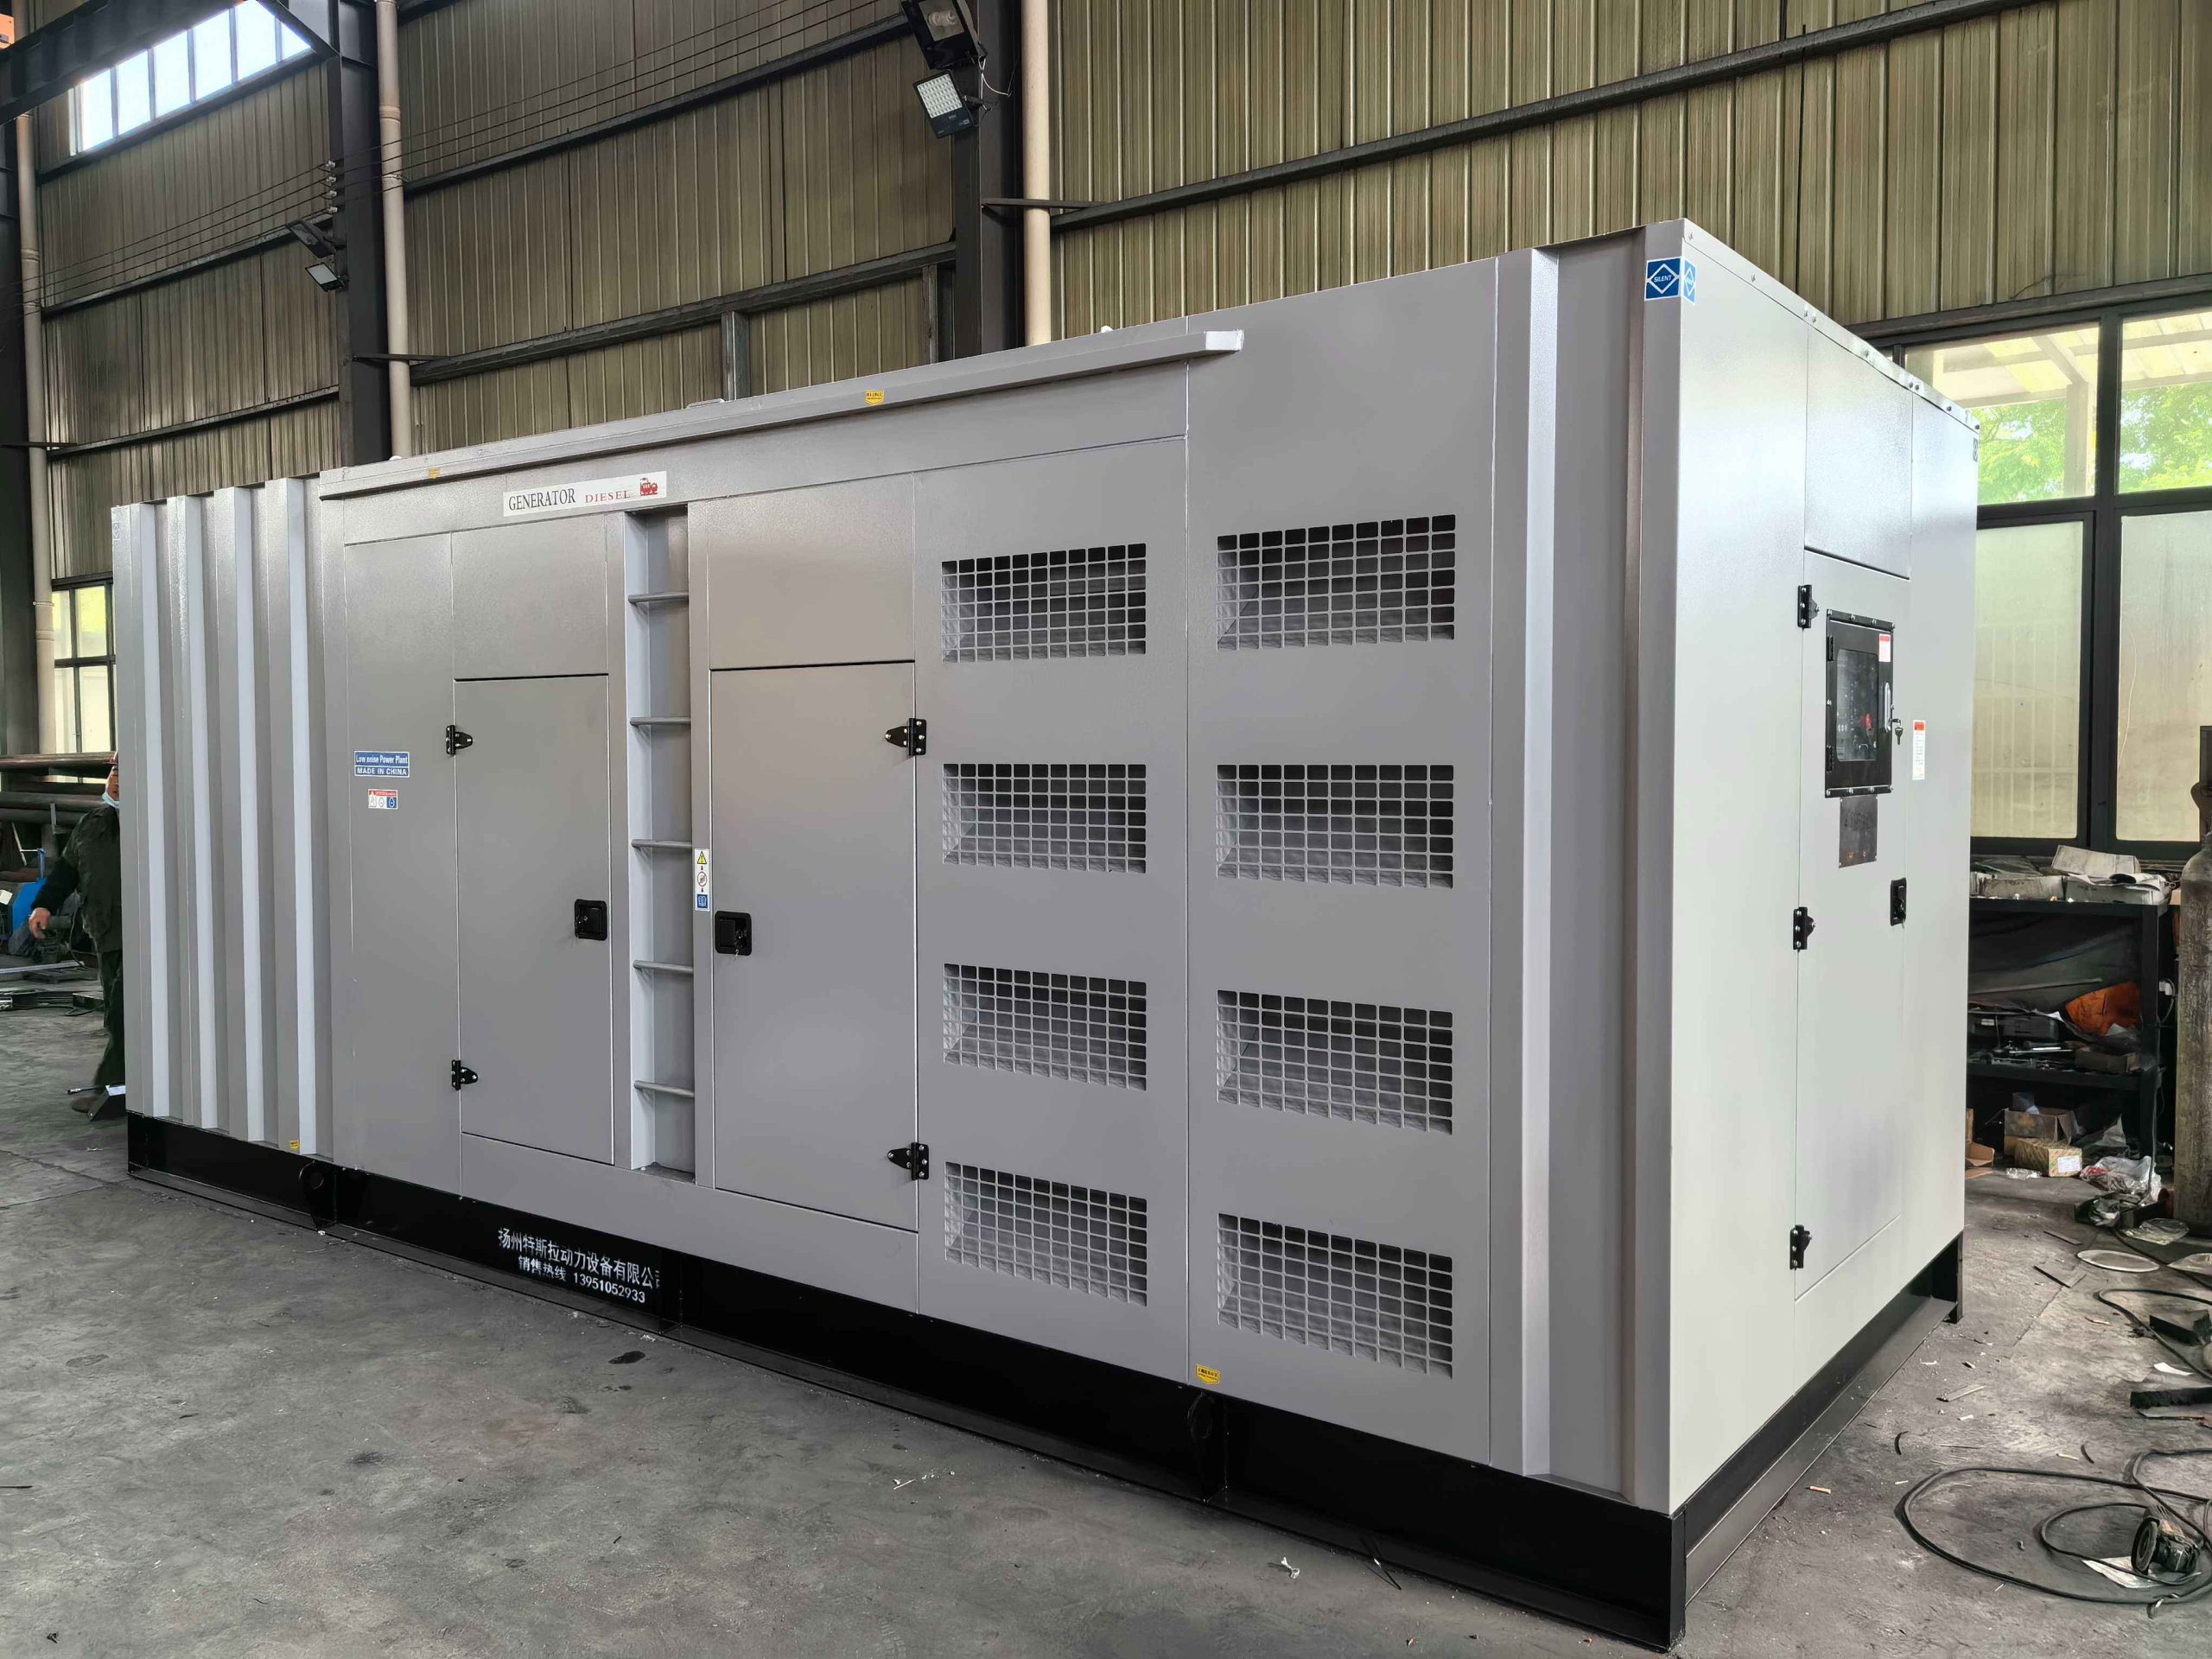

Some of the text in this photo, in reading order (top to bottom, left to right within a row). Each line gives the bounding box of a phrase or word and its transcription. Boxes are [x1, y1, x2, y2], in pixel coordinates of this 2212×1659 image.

[508, 487, 631, 512] GENERATOR DIESEL
[356, 753, 365, 763] Low
[379, 754, 394, 764] Power
[395, 754, 408, 764] Plant
[518, 1255, 645, 1304] 销售热线 13951052933
